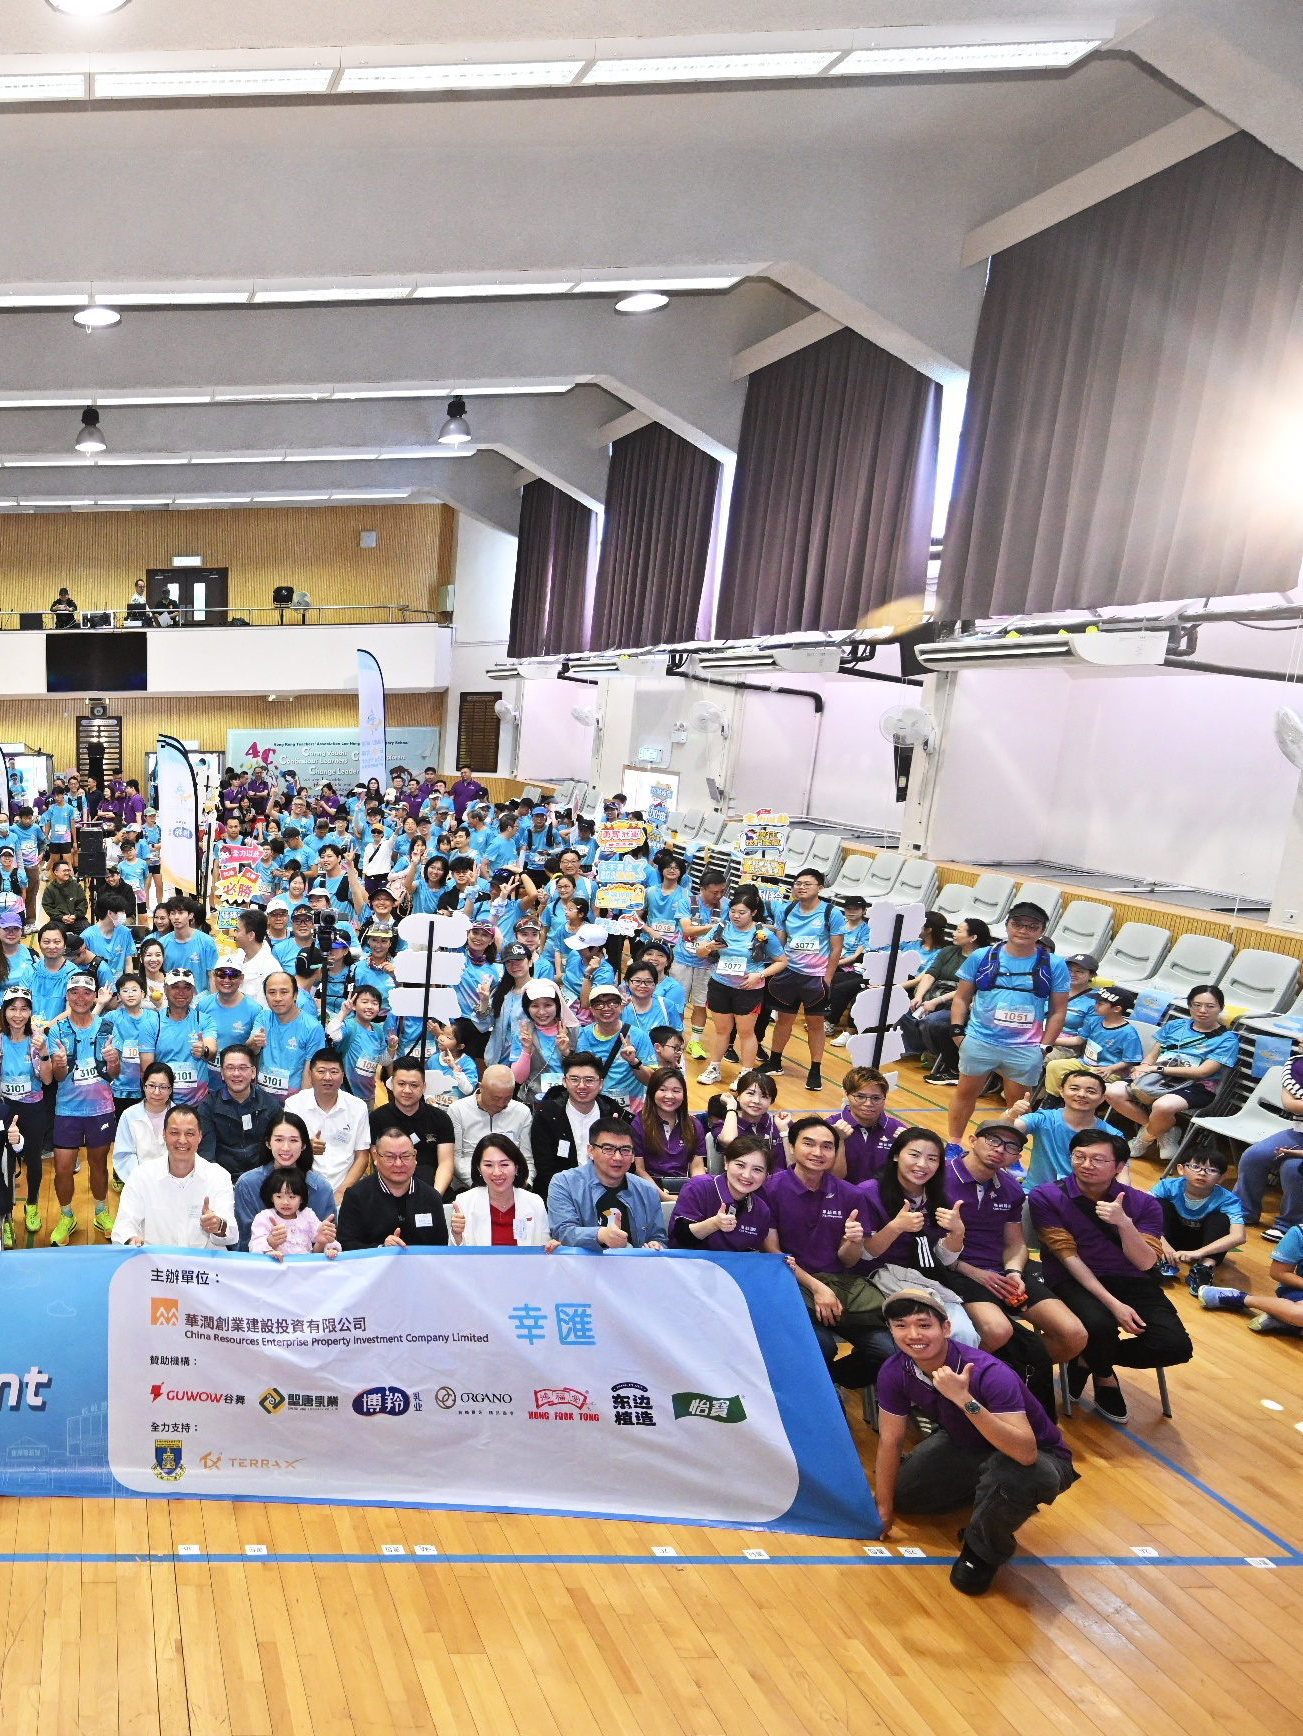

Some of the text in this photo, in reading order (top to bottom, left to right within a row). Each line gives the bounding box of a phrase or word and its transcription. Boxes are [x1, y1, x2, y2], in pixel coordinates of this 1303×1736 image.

[309, 765, 360, 776] Change Leader
[232, 850, 260, 858] 全力以赴
[222, 882, 253, 899] 必勝
[722, 962, 742, 970] 3077
[1003, 1012, 1028, 1022] 1051
[262, 1075, 283, 1087] 3101
[5, 1084, 26, 1093] 3101
[150, 1268, 220, 1286] 主辦單位：
[184, 1312, 367, 1335] 華潤創業建設投資有限公司
[507, 1303, 597, 1345] 幸匯
[184, 1330, 489, 1348] China Resources Enterprise Property Investment Company Limited
[166, 1390, 224, 1404] GUWOW
[460, 1392, 513, 1404] ORGANO
[688, 1398, 730, 1418] 怡寶
[554, 1411, 575, 1421] FOOK
[578, 1412, 600, 1422] TONG
[150, 1421, 198, 1434] 全力支持：
